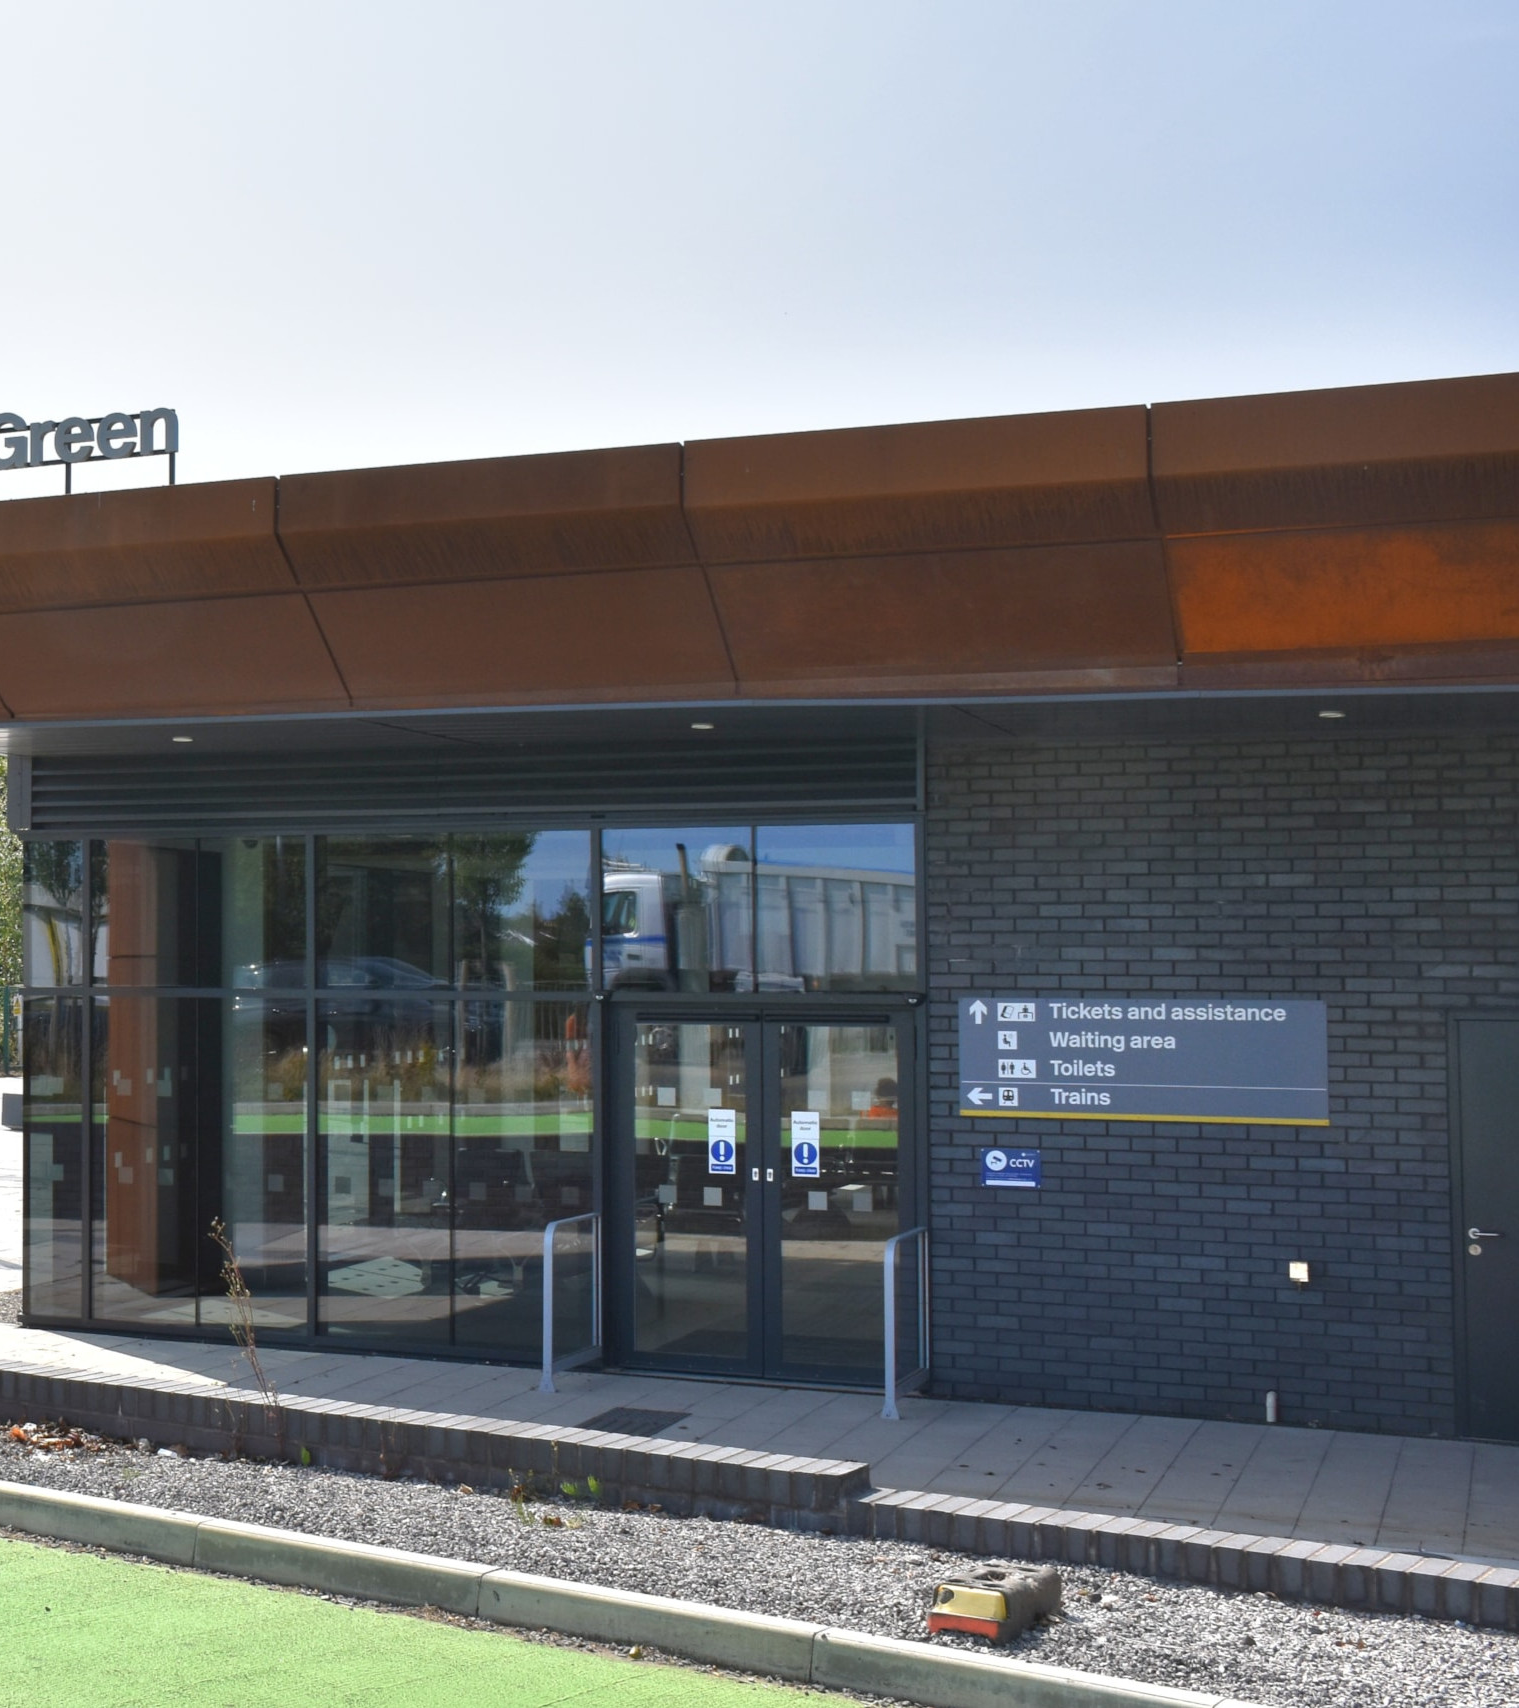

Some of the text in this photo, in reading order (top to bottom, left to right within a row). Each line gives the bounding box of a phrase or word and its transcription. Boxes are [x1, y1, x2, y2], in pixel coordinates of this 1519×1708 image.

[1049, 1002, 1287, 1022] Tickets and assistance
[1049, 1031, 1176, 1052] Waiting area
[1050, 1060, 1116, 1078] Toilets
[1051, 1088, 1110, 1106] Trains
[1010, 1158, 1034, 1168] CCTV
